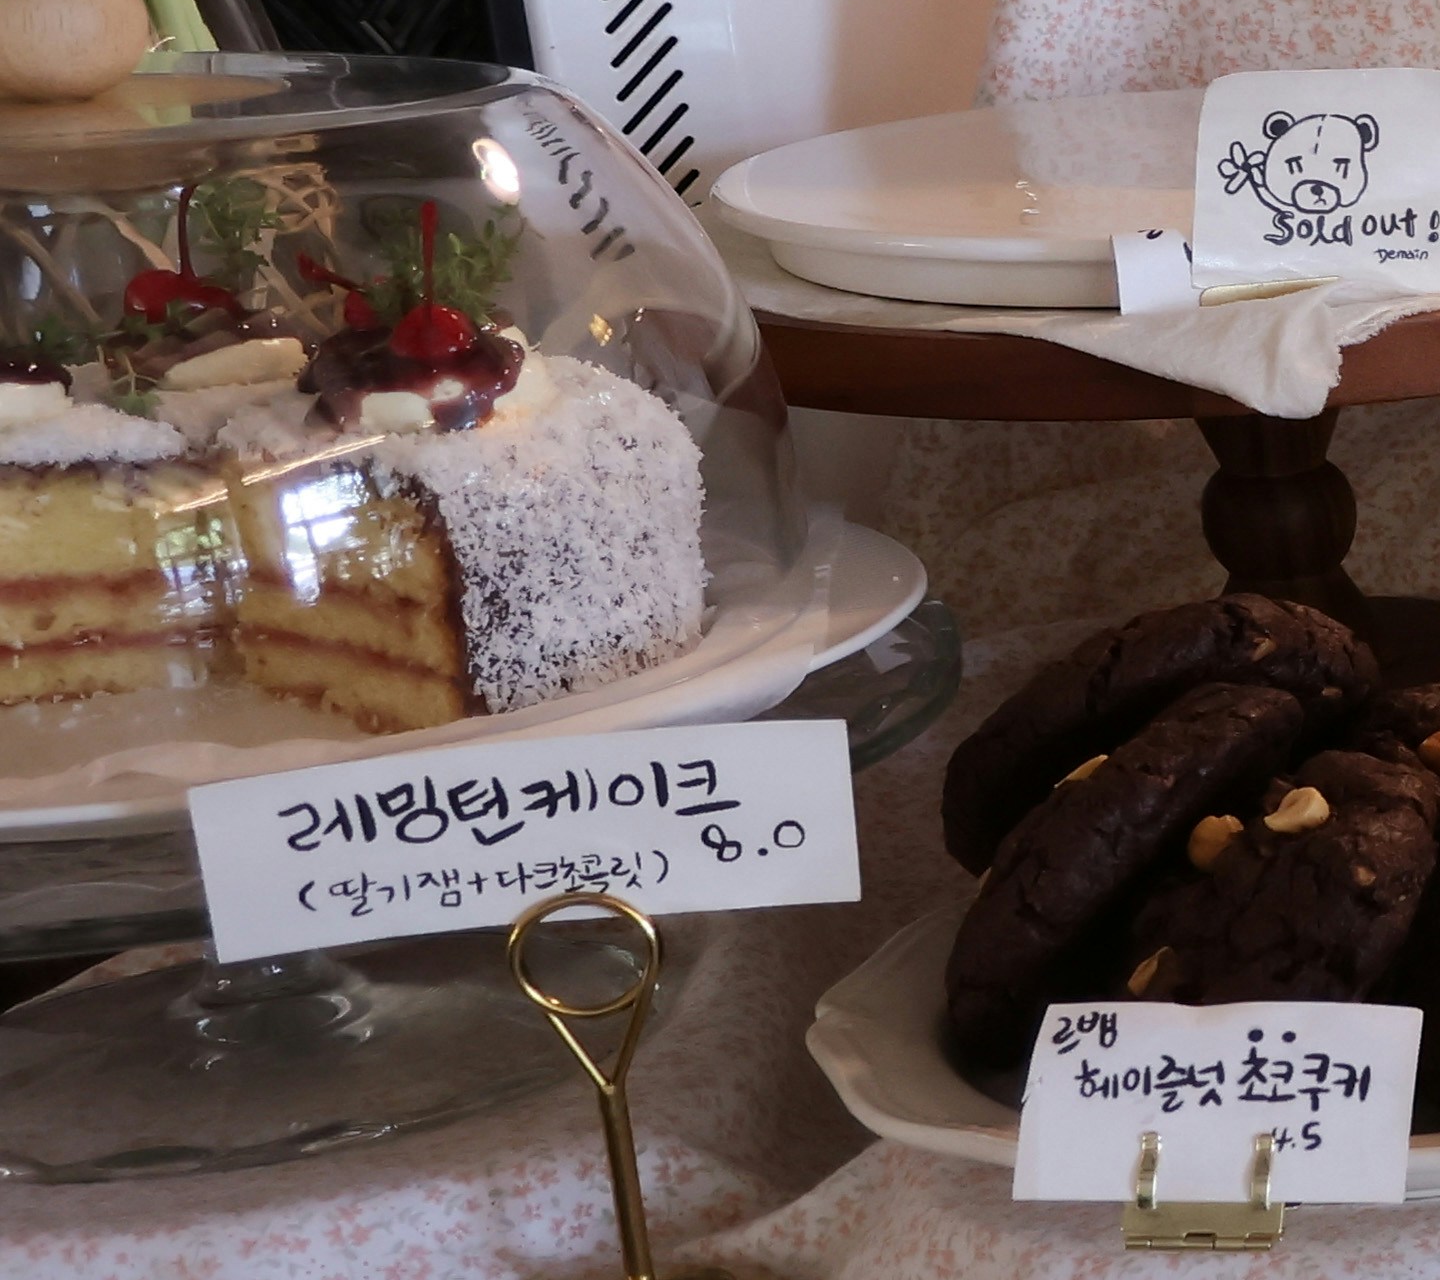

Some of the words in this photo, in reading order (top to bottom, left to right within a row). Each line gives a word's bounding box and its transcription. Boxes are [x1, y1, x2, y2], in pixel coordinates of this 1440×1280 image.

[1263, 210, 1352, 246] Sold
[278, 759, 740, 852] 레밍턴케이크
[700, 819, 806, 864] 8.0
